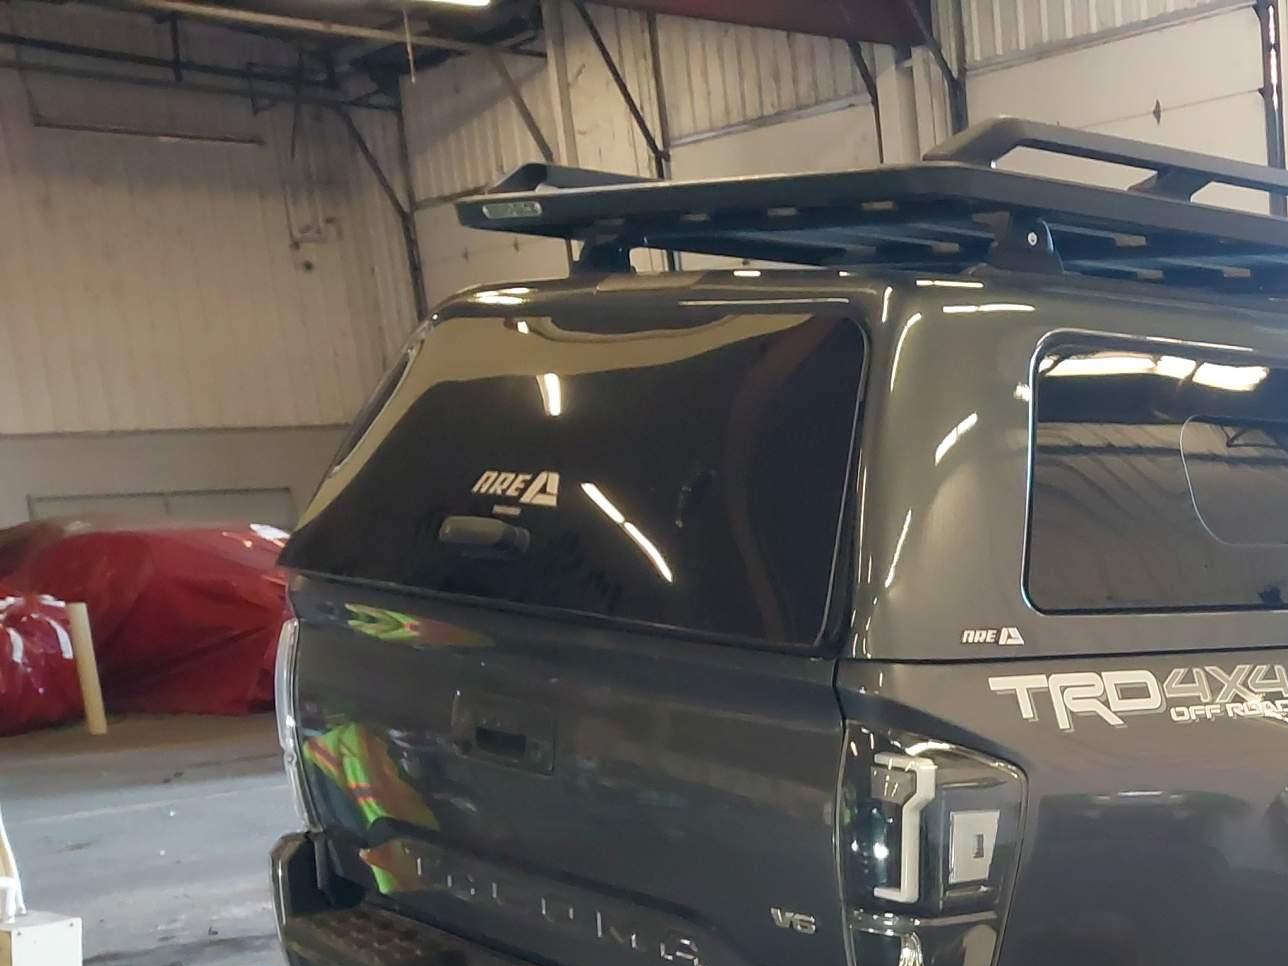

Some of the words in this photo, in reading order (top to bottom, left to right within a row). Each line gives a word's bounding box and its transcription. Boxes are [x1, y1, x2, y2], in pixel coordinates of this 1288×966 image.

[988, 669, 1166, 732] TRD
[1170, 704, 1224, 722] OFF
[769, 906, 817, 935] V6
